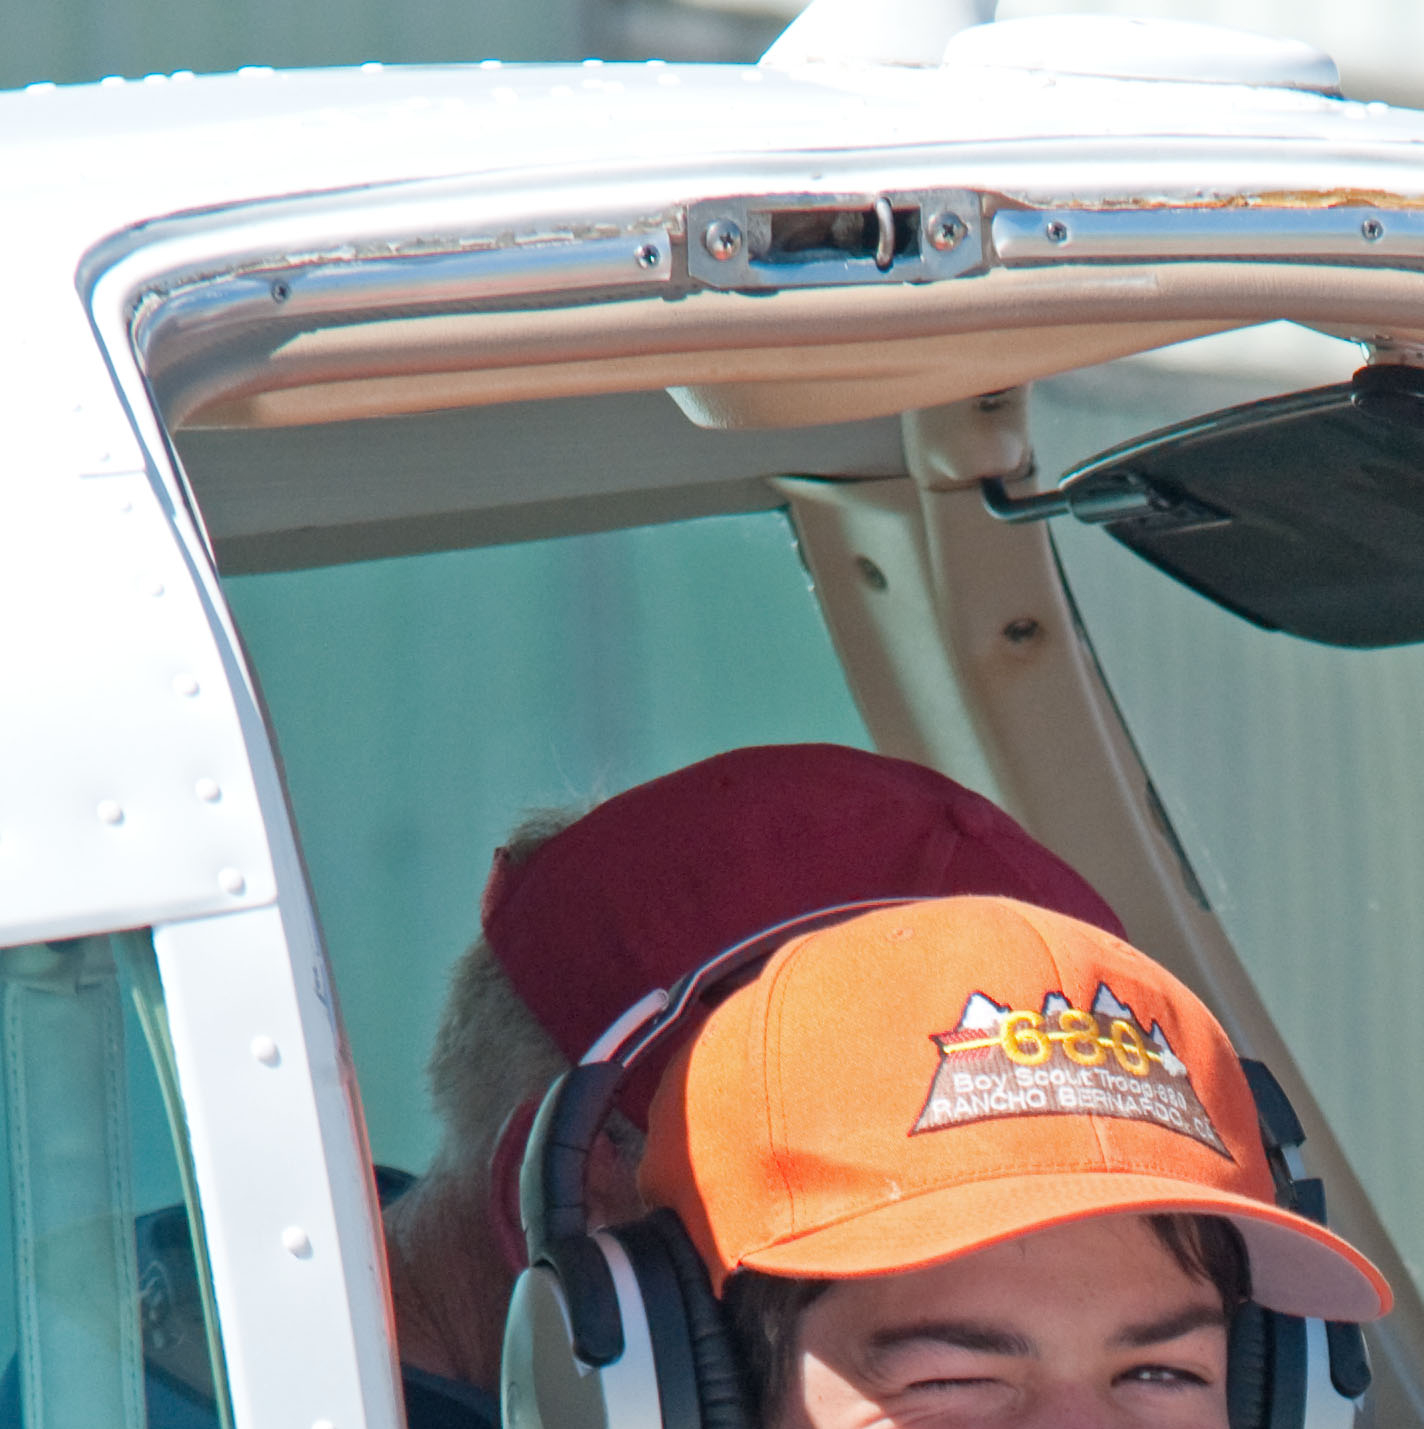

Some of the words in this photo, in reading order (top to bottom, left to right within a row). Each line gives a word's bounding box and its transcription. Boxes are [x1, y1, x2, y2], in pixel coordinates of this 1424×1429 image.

[953, 1071, 1007, 1094] Boy
[1014, 1066, 1093, 1087] Scout
[931, 1088, 1046, 1120] RANCHO
[1193, 1115, 1217, 1141] CA
